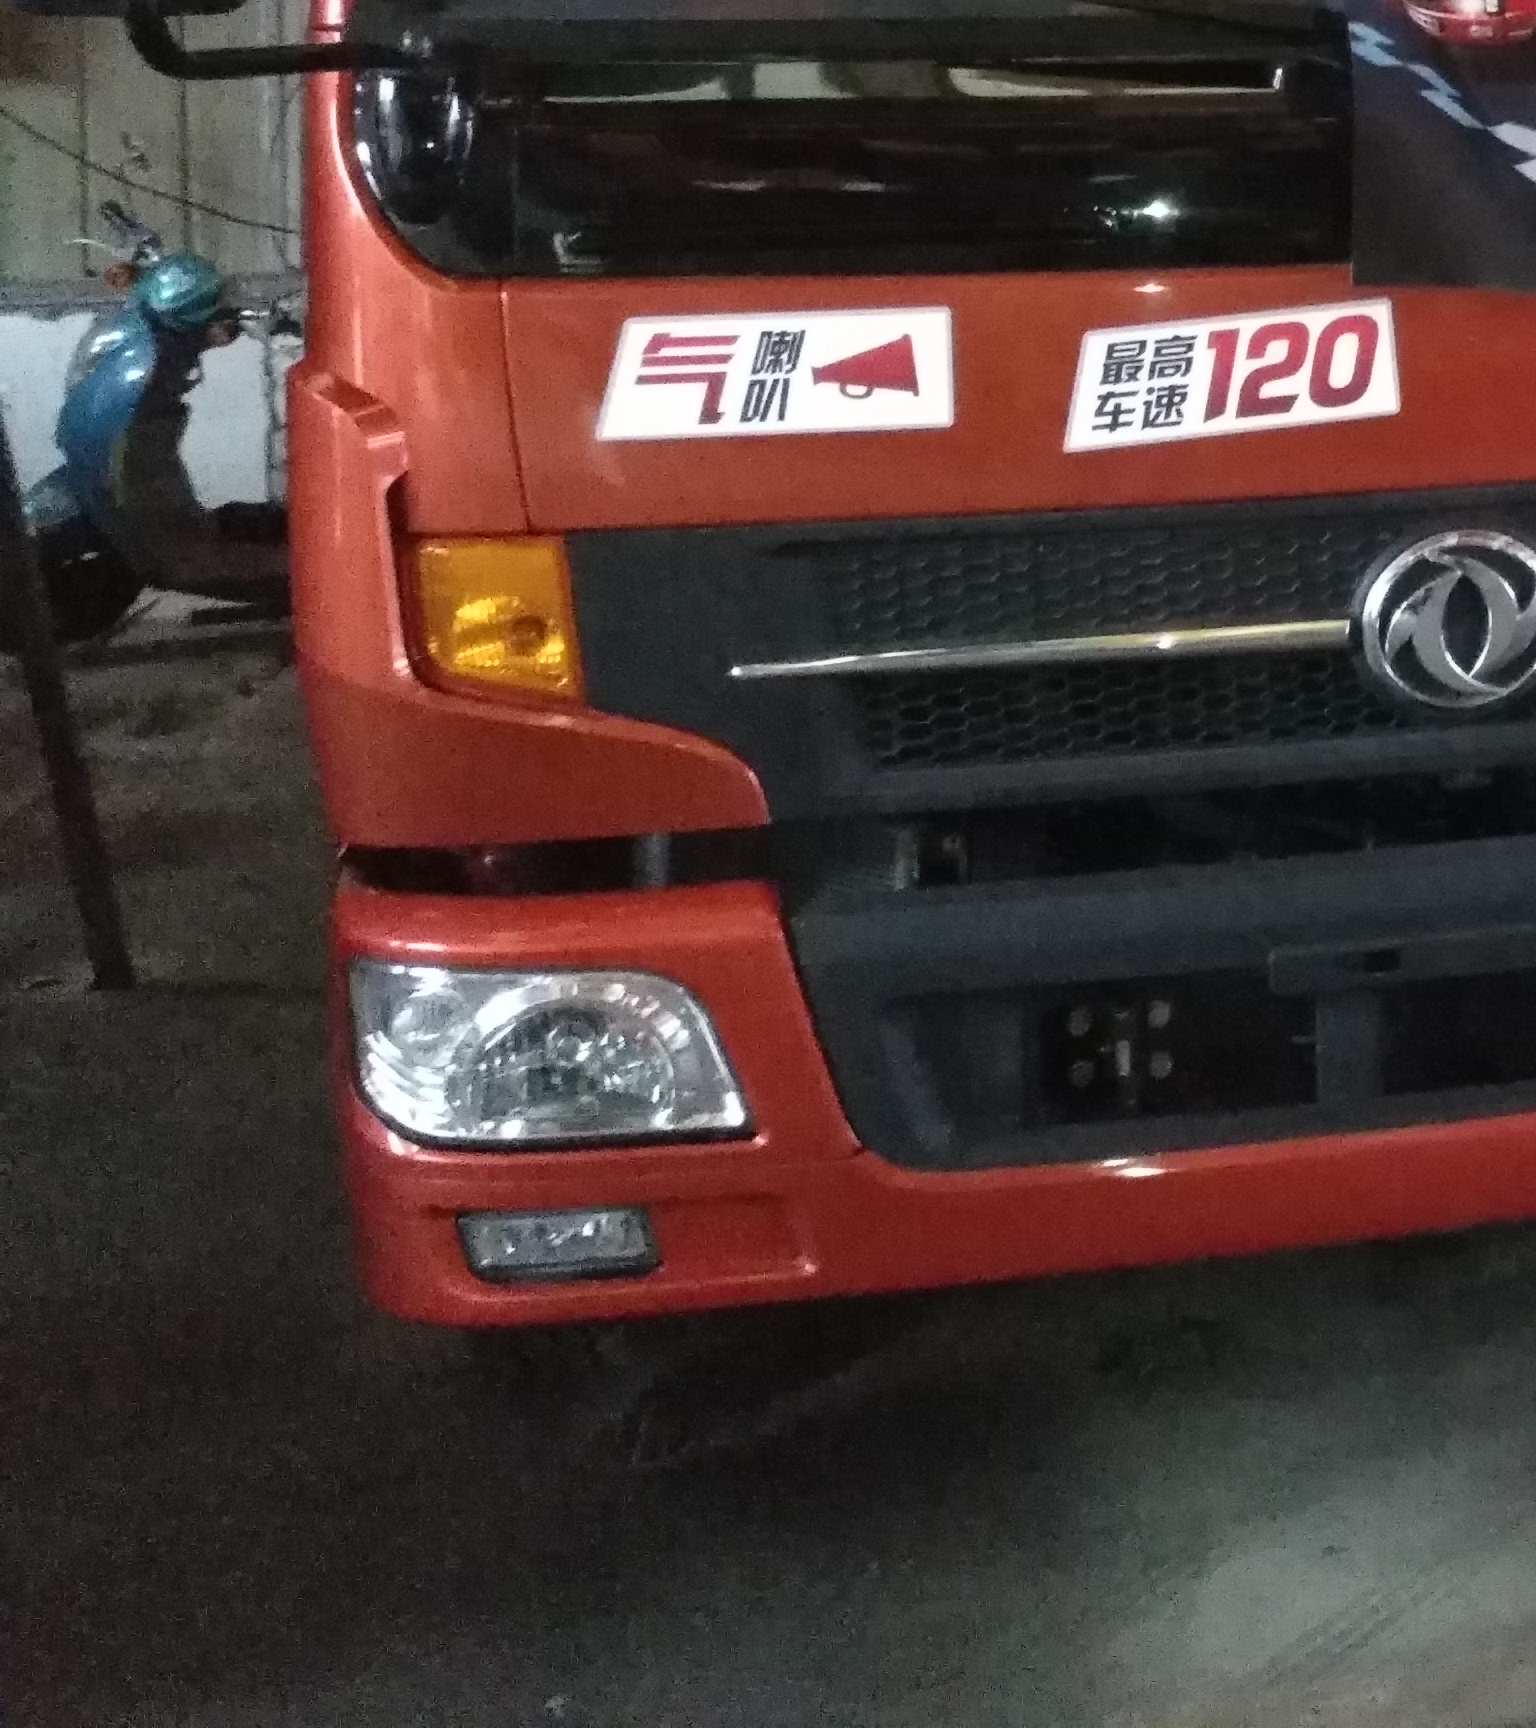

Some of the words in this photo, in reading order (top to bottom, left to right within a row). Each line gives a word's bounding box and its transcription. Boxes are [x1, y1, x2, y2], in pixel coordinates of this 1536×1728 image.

[1099, 334, 1199, 386] 最高
[1203, 313, 1380, 424] 120
[1091, 383, 1190, 434] 车速
